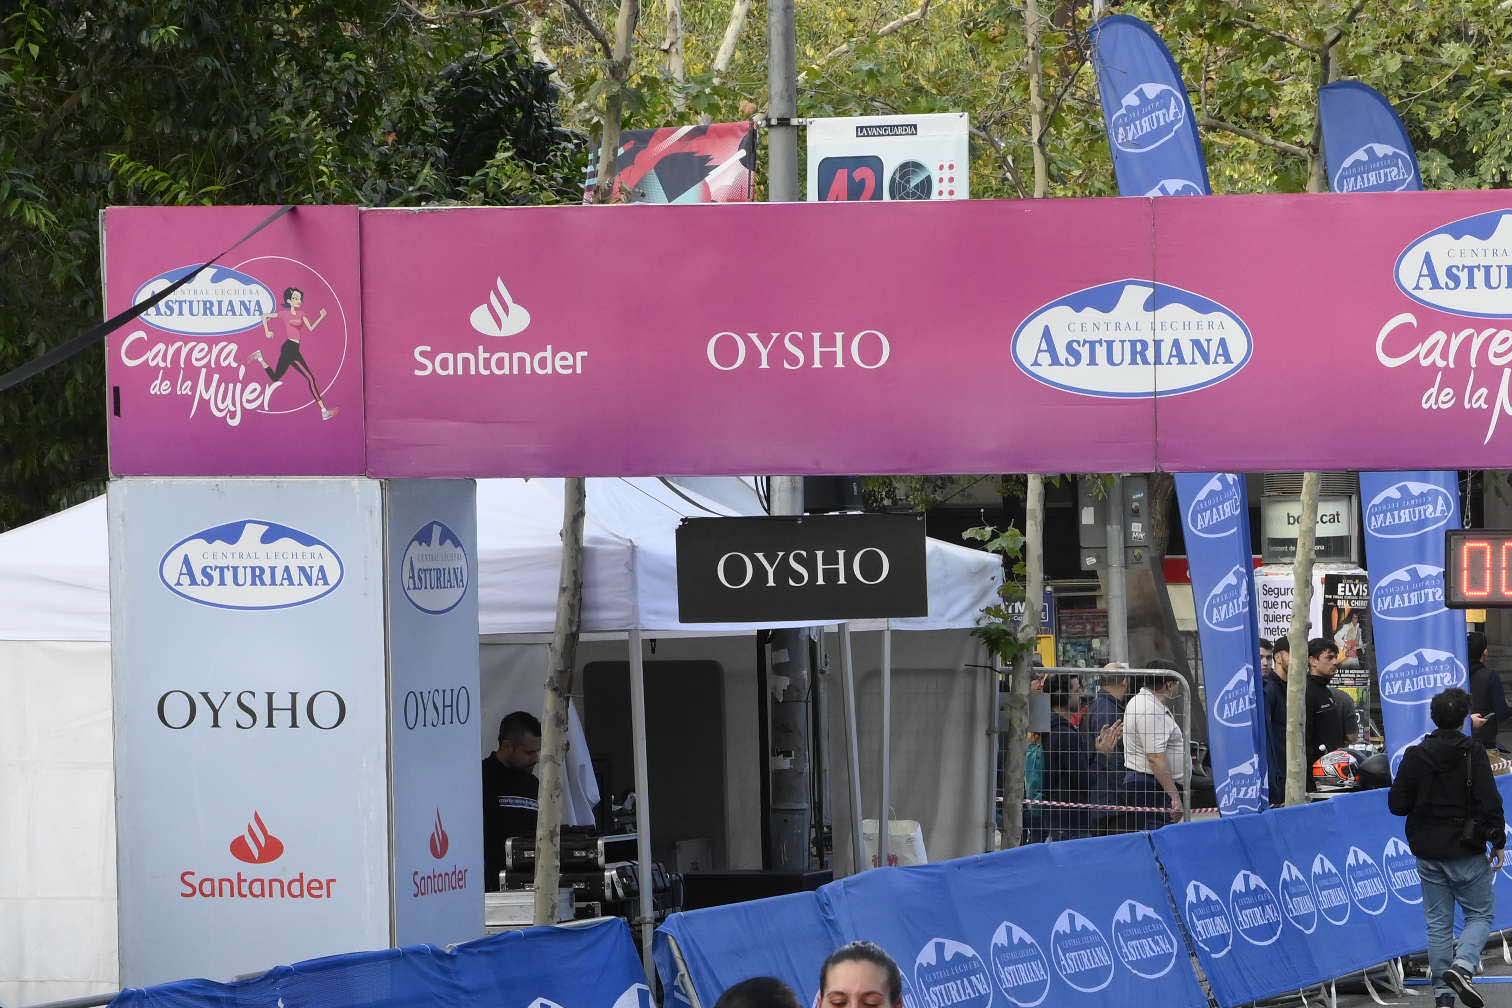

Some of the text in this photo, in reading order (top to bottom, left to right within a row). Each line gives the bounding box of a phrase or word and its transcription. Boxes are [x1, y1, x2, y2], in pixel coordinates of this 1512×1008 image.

[143, 290, 264, 317] ASTURIANA
[1068, 320, 1226, 332] CENTRAL LECHERA
[121, 331, 239, 368] Carrera
[414, 344, 588, 375] Santander
[707, 330, 891, 372] OYSHO
[1031, 325, 1234, 368] ASTURIANA
[150, 365, 282, 426] de la Mujer
[1422, 371, 1455, 410] de
[1464, 369, 1488, 409] la
[174, 553, 330, 587] ASTURIANA
[202, 551, 324, 560] CENTRAL LECHERA
[717, 548, 891, 590] OYSHO
[407, 556, 464, 591] ASTURIANA
[1338, 583, 1368, 595] ELVIS
[1262, 600, 1279, 612] que
[157, 690, 347, 729] OYSHO
[404, 686, 471, 730] OYSHO
[180, 871, 337, 899] Santander
[412, 865, 468, 898] Santander
[997, 957, 1047, 988] ASTURIANA
[1057, 942, 1111, 974] ASTURIANA
